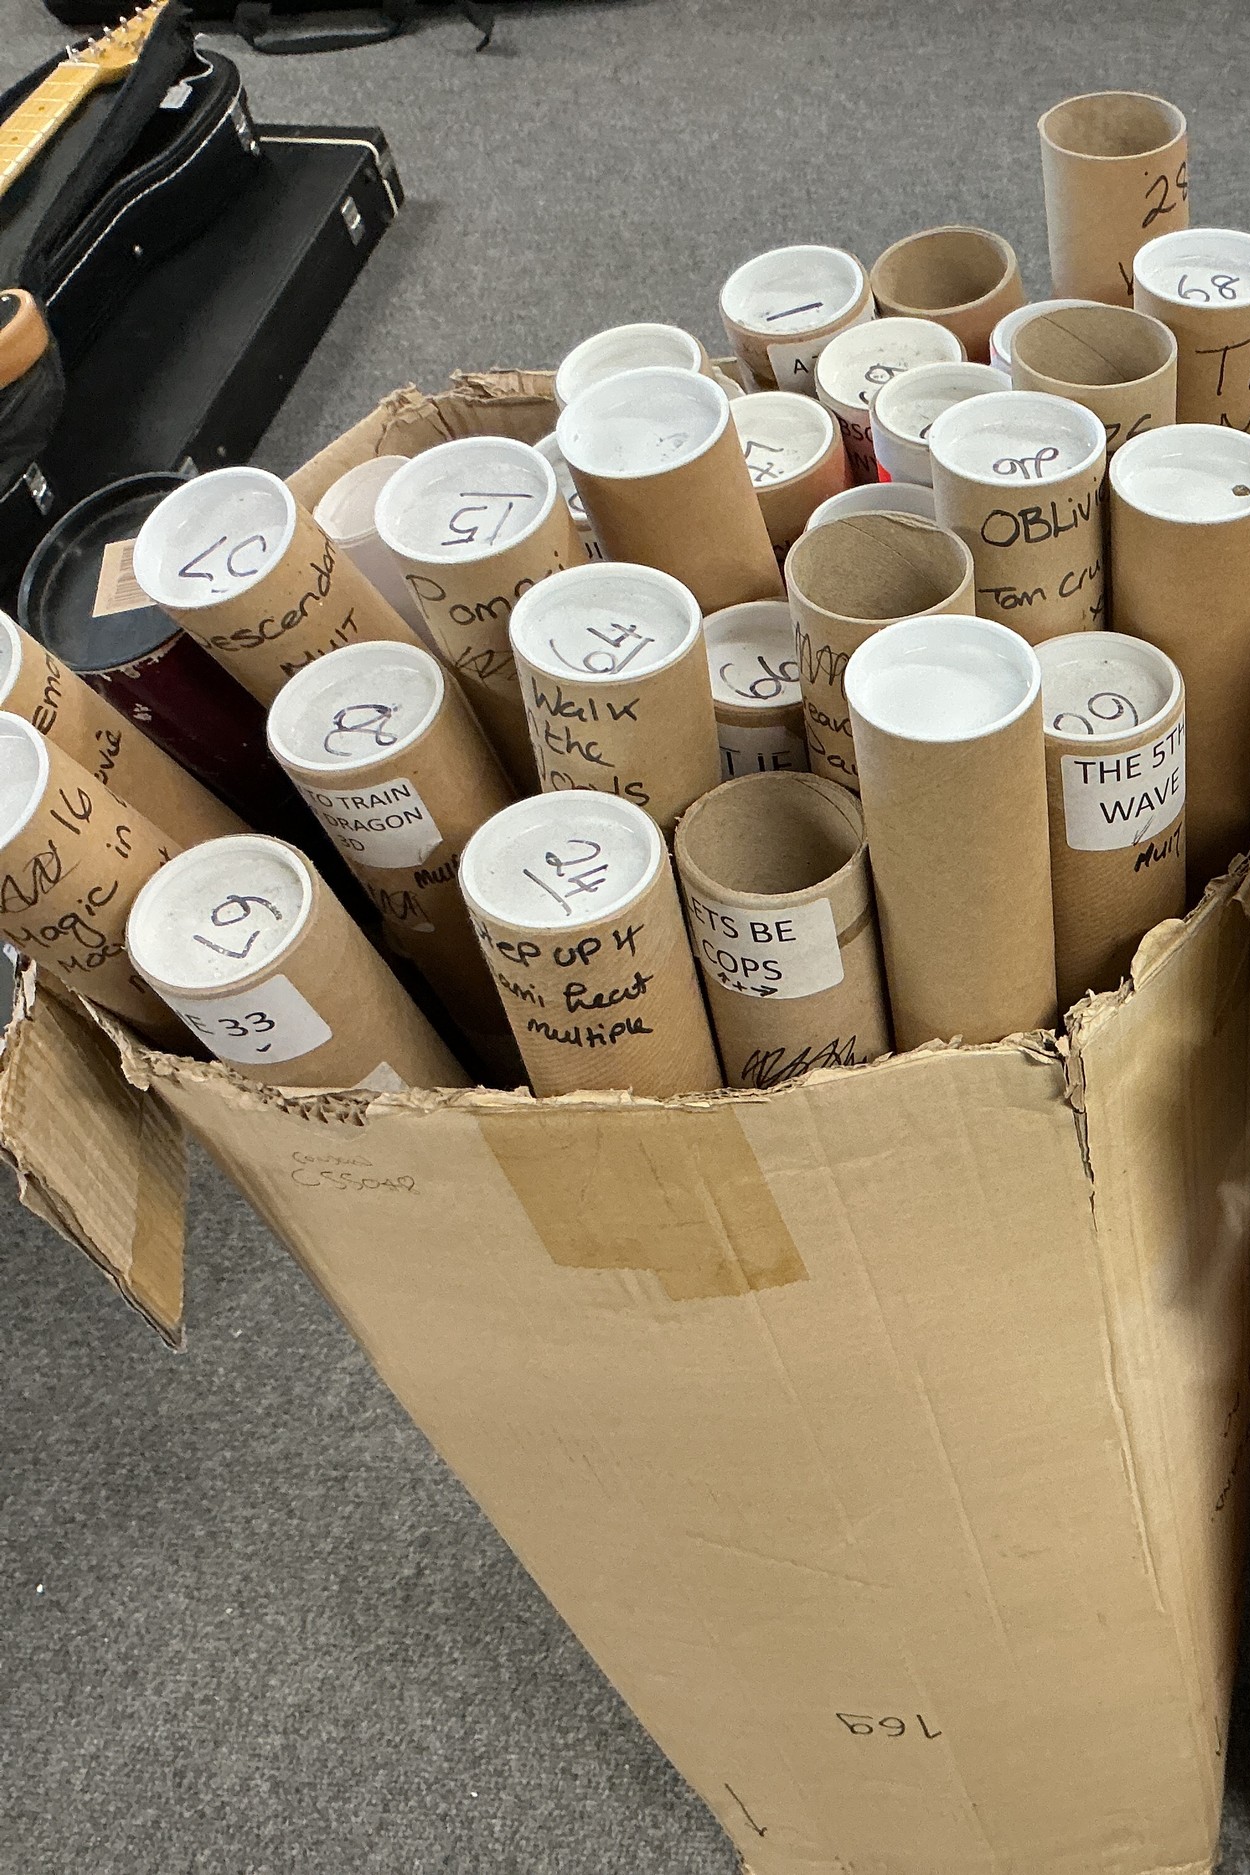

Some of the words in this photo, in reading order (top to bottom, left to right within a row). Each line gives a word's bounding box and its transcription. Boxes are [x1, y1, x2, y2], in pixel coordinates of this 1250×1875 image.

[978, 586, 1047, 610] Tom
[532, 676, 640, 722] Walk
[545, 720, 615, 768] the
[1074, 753, 1142, 784] THE
[1153, 723, 1185, 769] 5TH
[50, 787, 92, 834] 16
[335, 784, 411, 810] TRAIN
[1100, 766, 1179, 824] WAVE
[323, 807, 423, 833] DRAGON
[106, 824, 133, 859] in
[3, 880, 118, 950] Magic
[750, 920, 797, 943] BE
[613, 924, 644, 957] 4
[702, 939, 782, 980] COPS
[218, 1012, 275, 1036] 33
